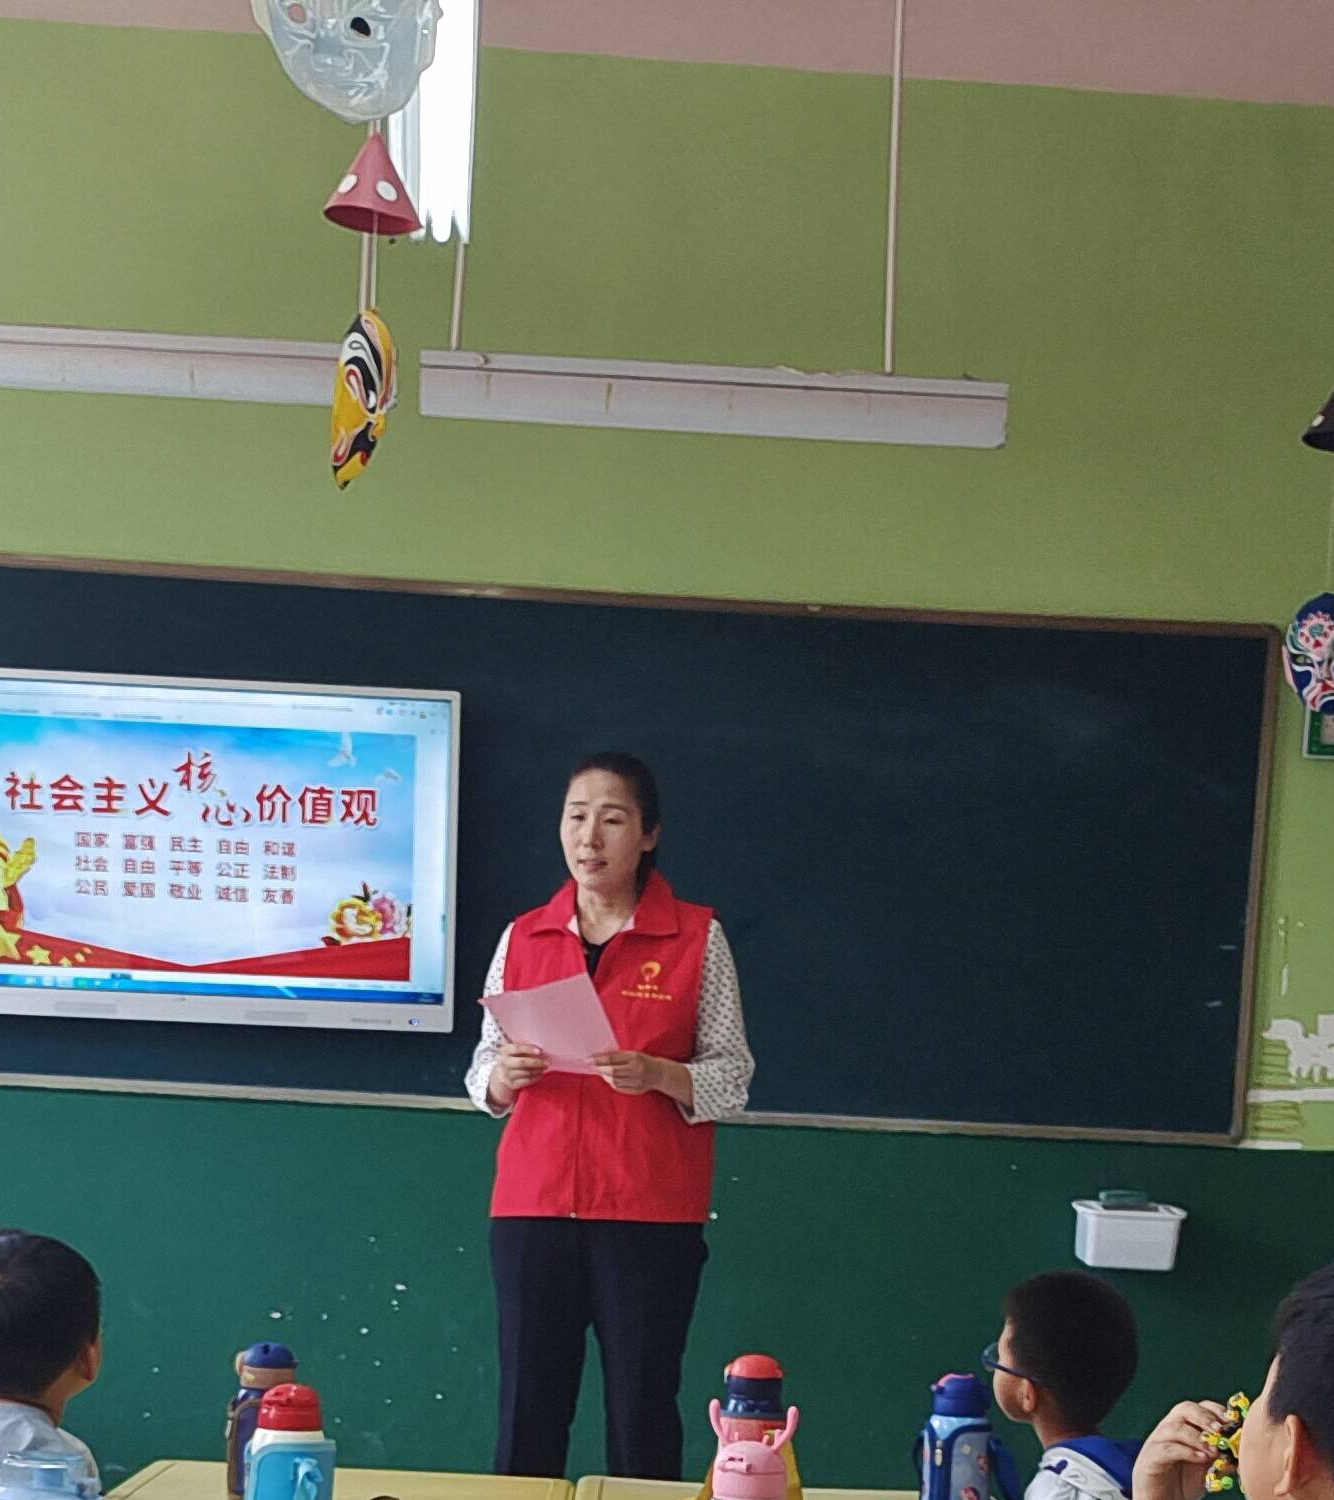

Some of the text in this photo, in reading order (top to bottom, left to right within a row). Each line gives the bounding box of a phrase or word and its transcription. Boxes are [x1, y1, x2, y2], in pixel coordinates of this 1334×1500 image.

[5, 751, 378, 827] 社会主义核心价值观
[75, 831, 109, 848] 国家
[170, 836, 203, 852] 民主
[218, 839, 249, 855] 自由
[75, 855, 109, 872] 社会
[124, 857, 155, 874] 自由
[169, 860, 203, 876] 平等
[217, 861, 250, 878] 公正
[75, 879, 109, 896] 公民
[123, 881, 155, 898] 爱国
